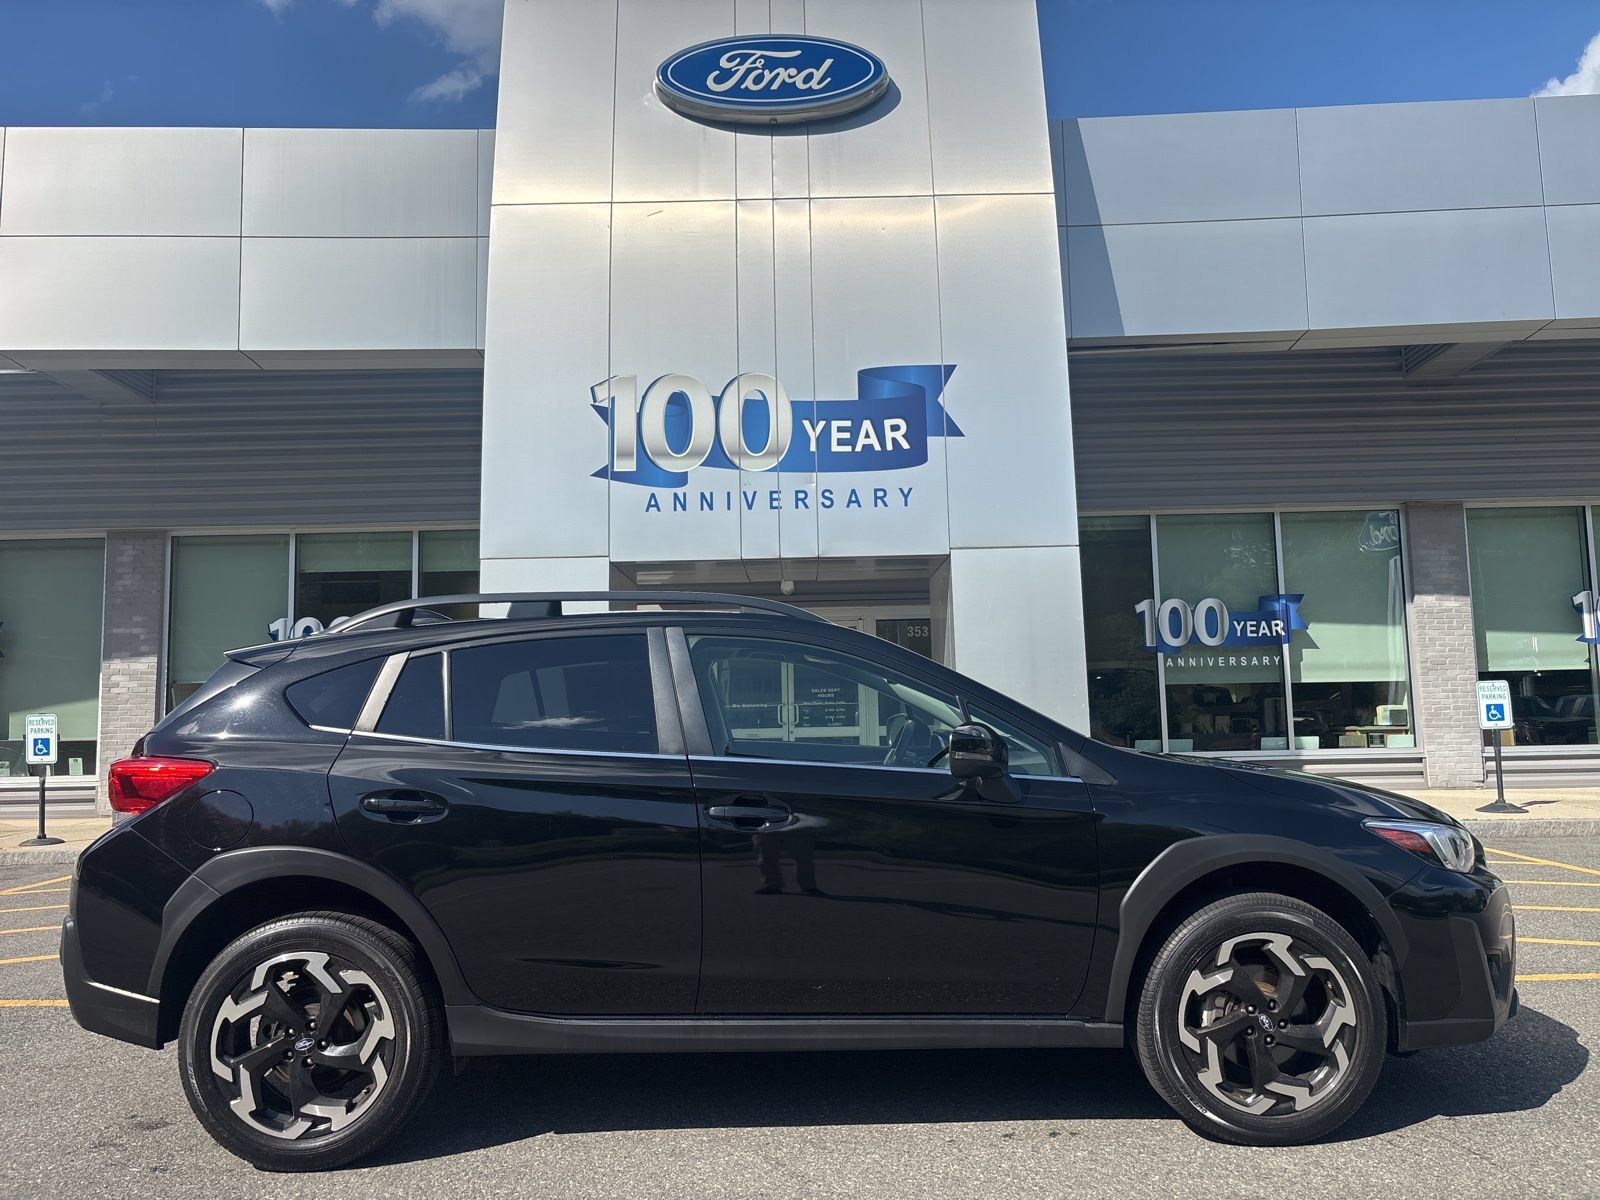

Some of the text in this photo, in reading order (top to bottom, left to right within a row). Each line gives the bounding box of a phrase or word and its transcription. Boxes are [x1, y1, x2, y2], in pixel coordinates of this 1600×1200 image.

[706, 49, 834, 92] Ford
[590, 372, 911, 473] 100 YEAR
[645, 487, 913, 512] ANNIVERSARY
[907, 625, 929, 637] 353
[1134, 597, 1285, 647] 100 YEAR
[1166, 655, 1281, 667] ANNIVERSARY
